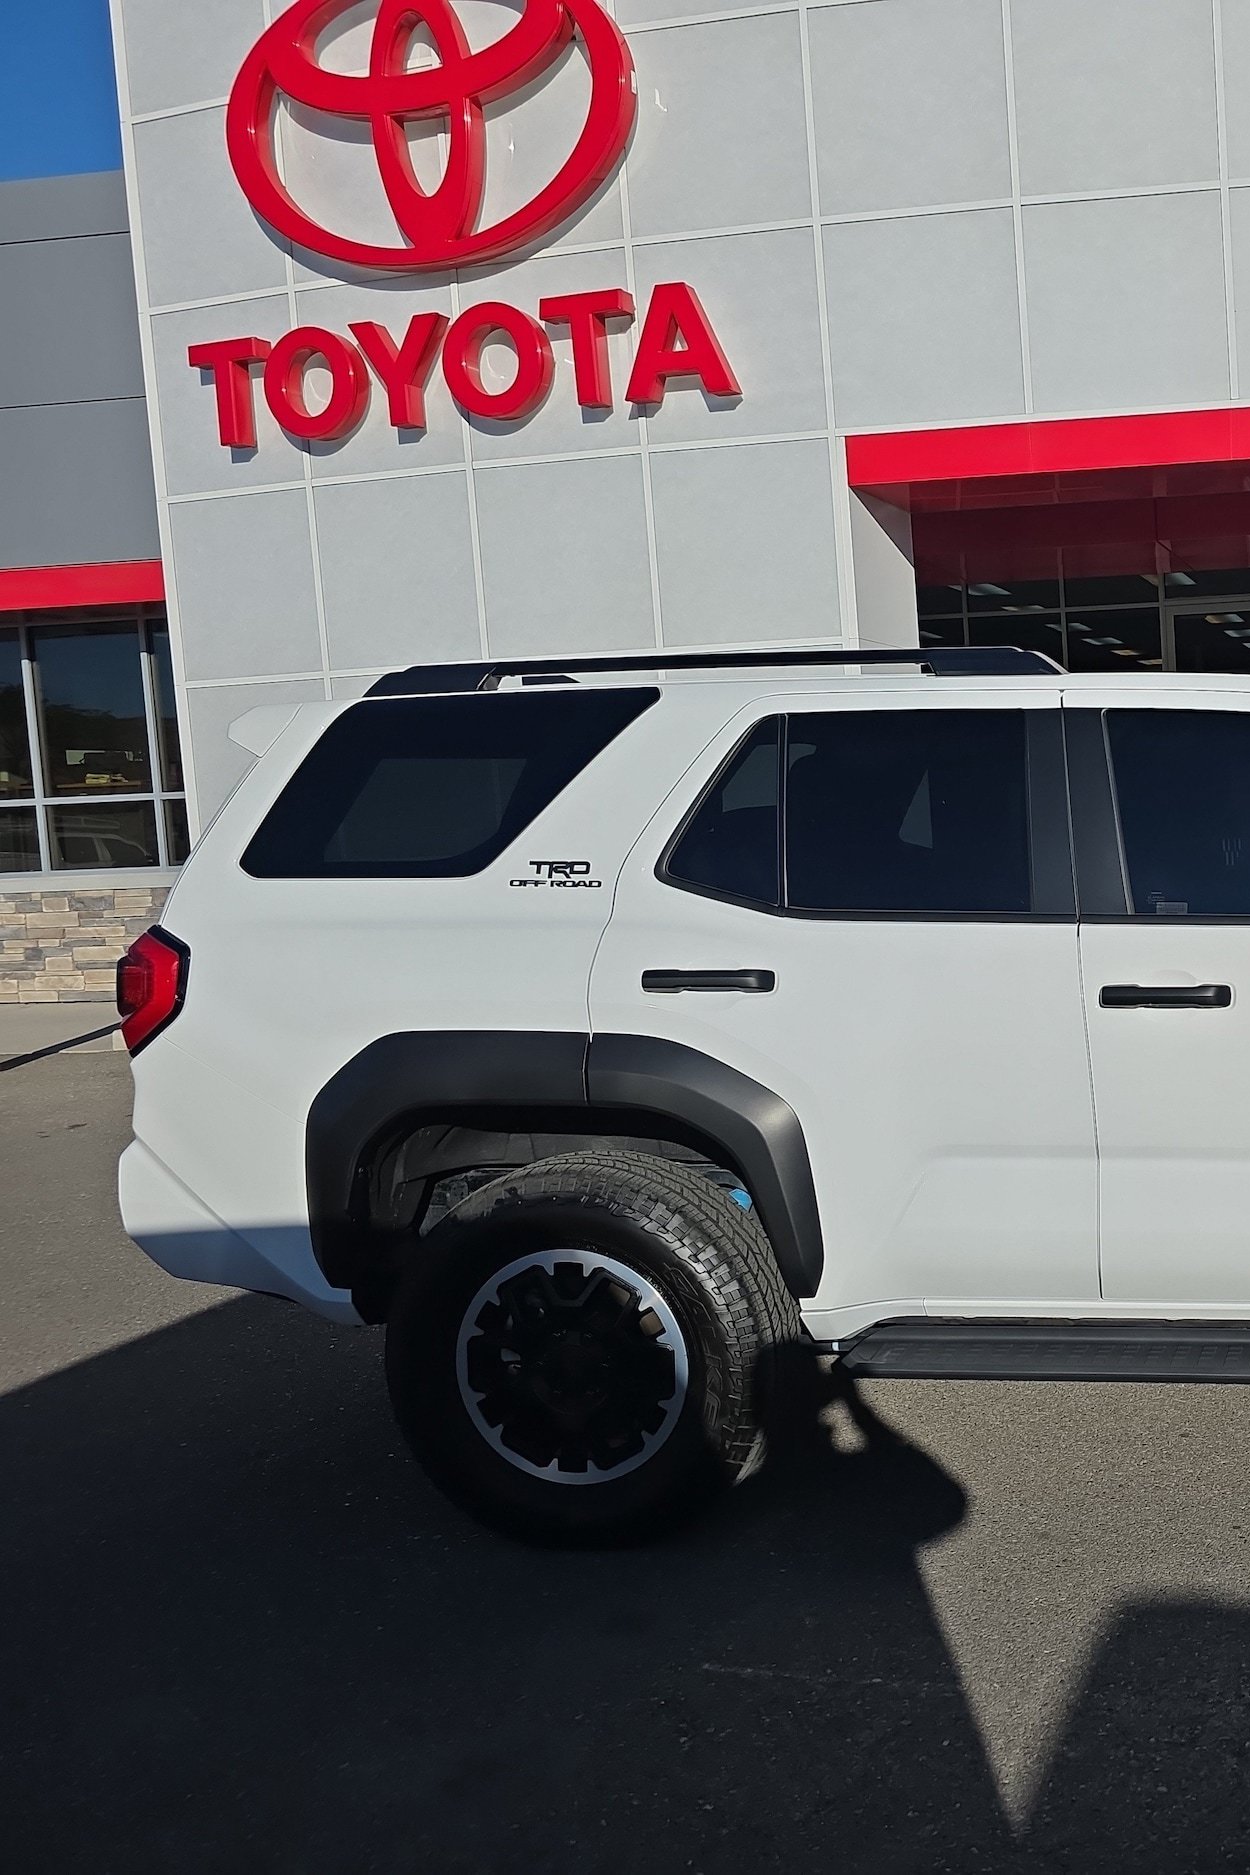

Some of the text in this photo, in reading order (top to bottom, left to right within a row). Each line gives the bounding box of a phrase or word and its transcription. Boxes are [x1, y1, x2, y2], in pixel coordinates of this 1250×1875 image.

[188, 282, 743, 448] TOYOTA
[529, 861, 591, 878] TRD
[550, 880, 602, 888] ROAD
